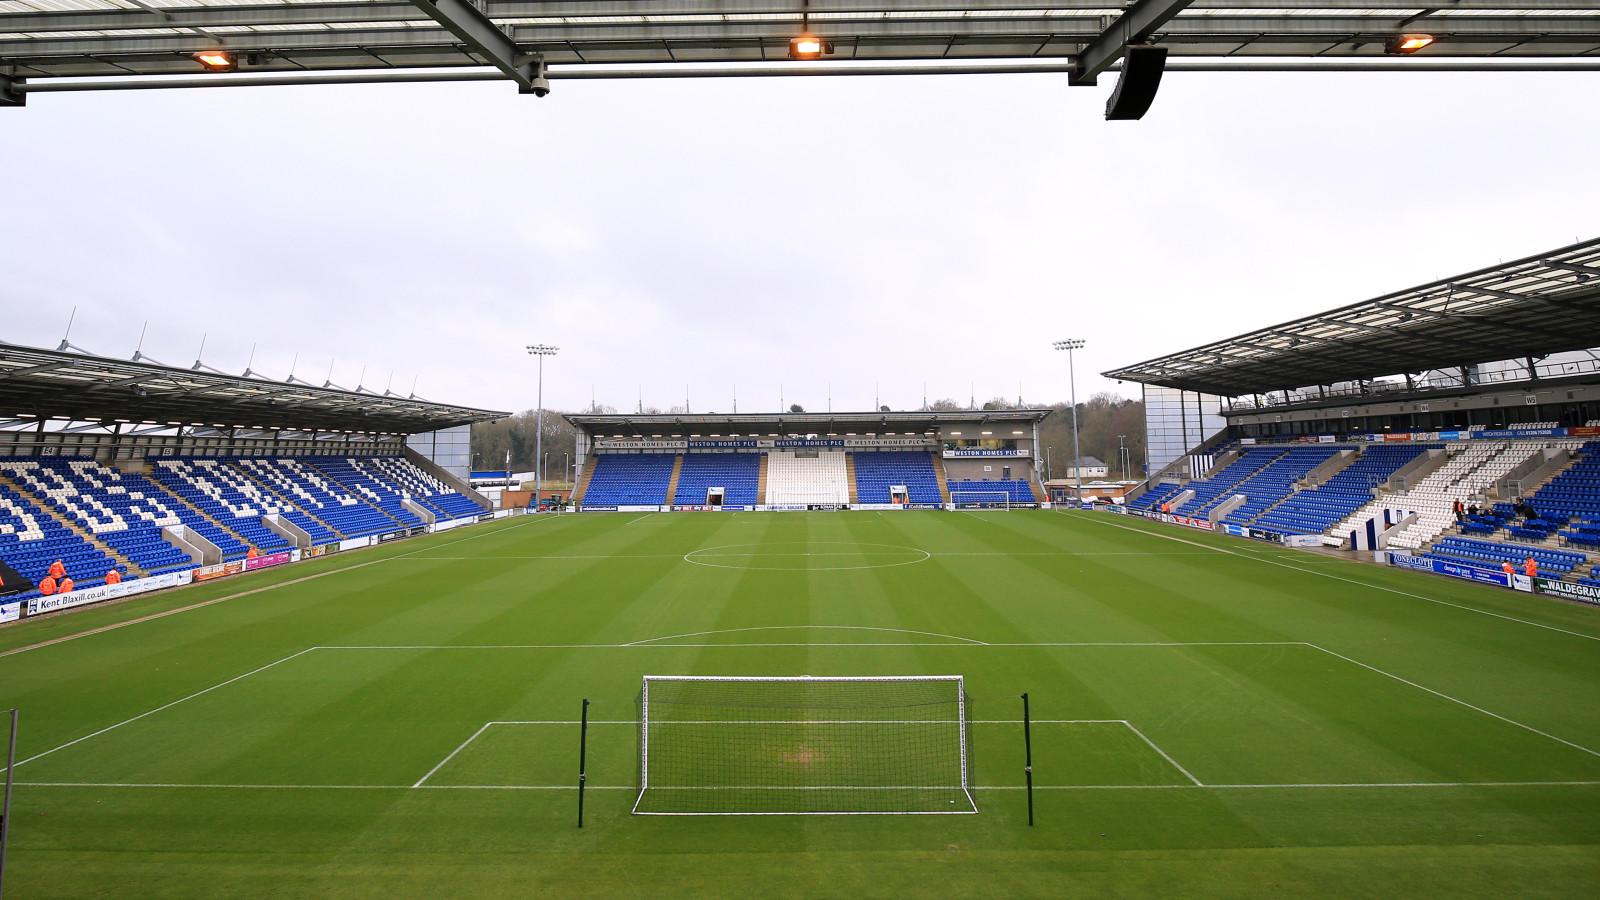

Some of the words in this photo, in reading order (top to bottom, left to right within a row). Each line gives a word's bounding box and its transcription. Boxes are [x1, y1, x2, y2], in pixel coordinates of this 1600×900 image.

[1393, 554, 1433, 568] ZONECLOTH
[40, 599, 60, 609] Kent
[62, 589, 106, 605] Blaxill.co.uk
